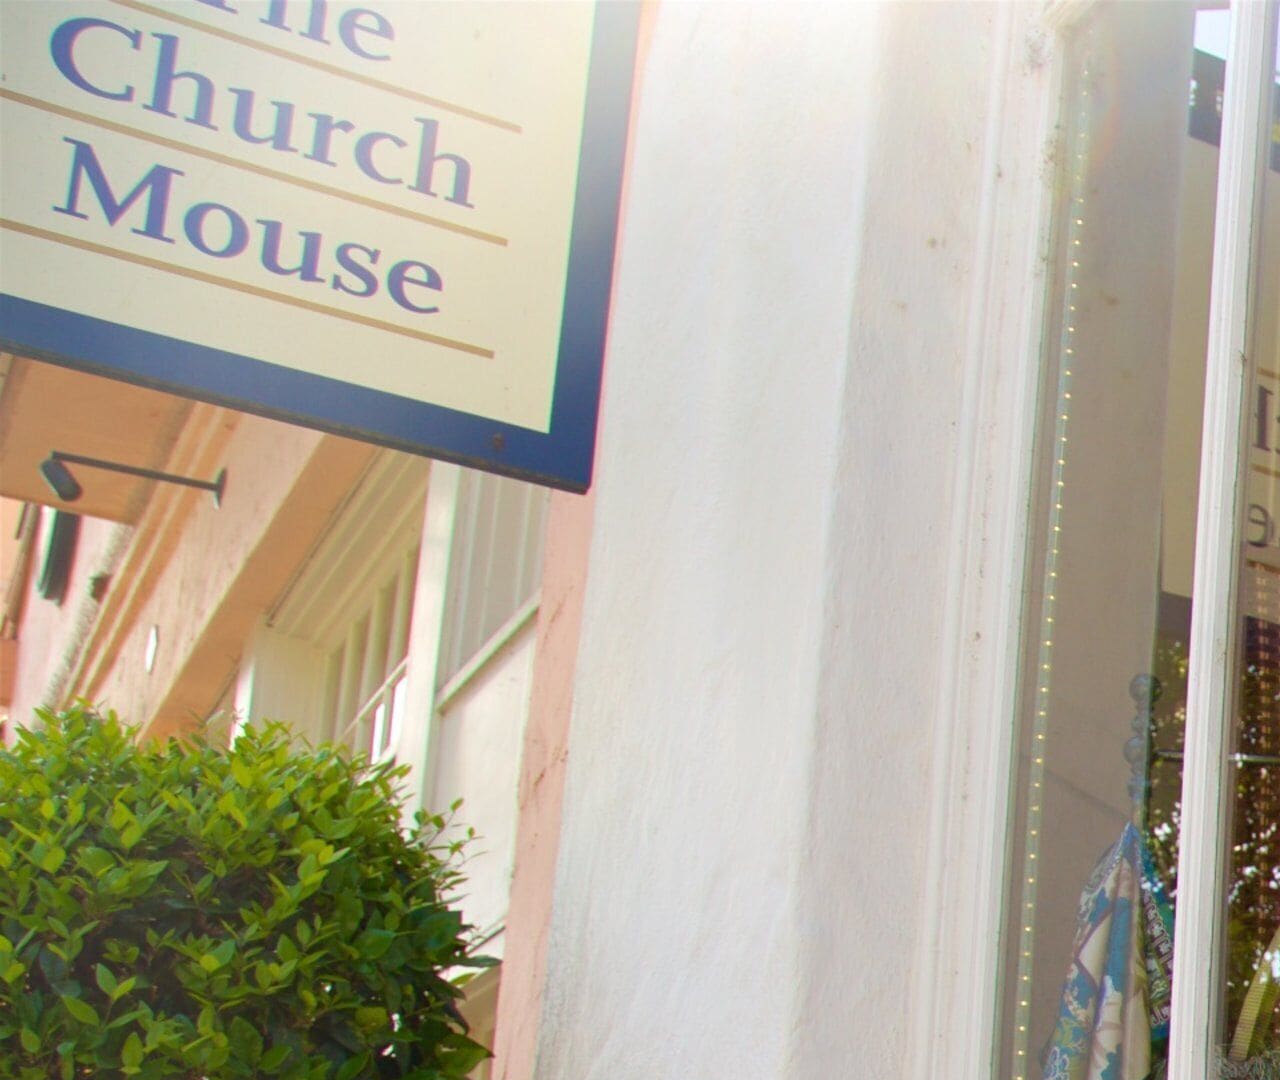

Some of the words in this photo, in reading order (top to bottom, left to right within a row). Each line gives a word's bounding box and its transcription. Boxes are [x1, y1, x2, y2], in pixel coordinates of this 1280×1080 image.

[50, 17, 475, 209] Church
[194, 0, 396, 62] he
[52, 136, 444, 314] Mouse
